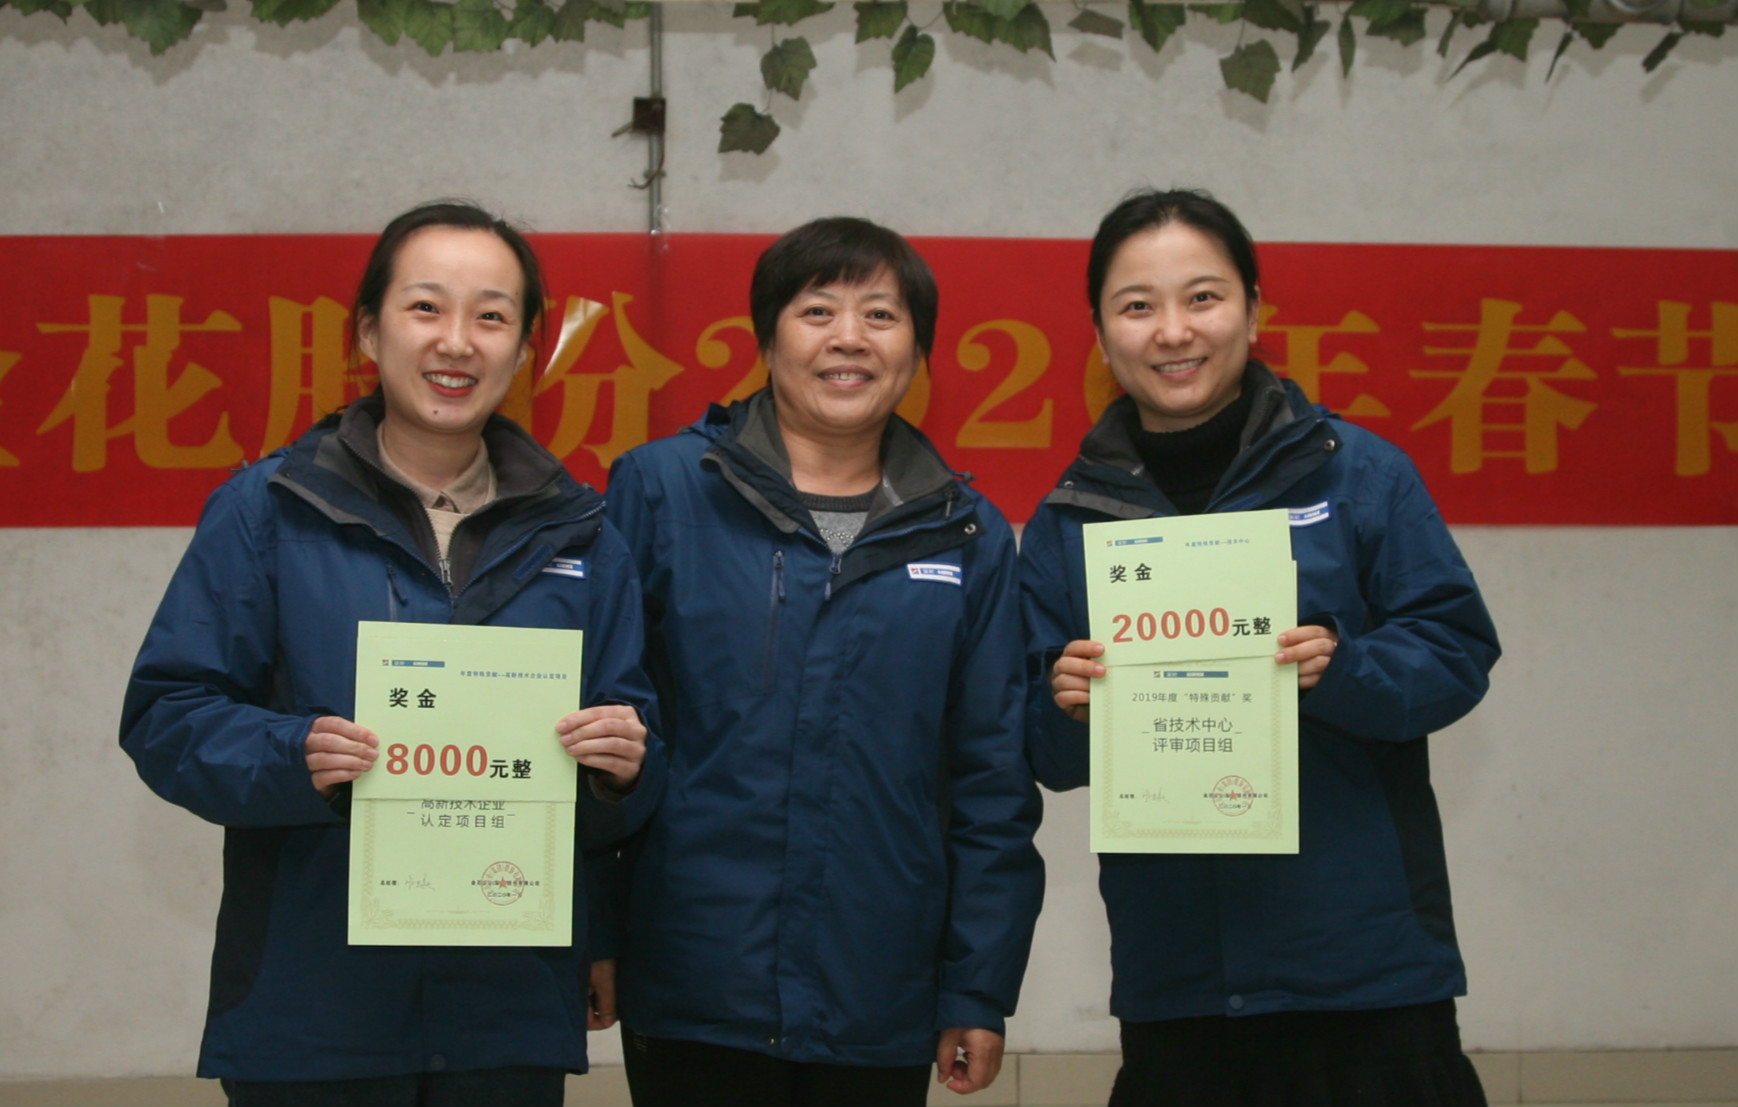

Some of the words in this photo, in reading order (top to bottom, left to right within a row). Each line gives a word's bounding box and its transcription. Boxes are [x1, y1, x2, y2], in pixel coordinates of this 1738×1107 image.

[1109, 563, 1152, 583] 奖金
[1112, 607, 1272, 643] 20000元整
[389, 687, 437, 709] 奖金
[1153, 717, 1233, 733] 省技术中心
[1153, 737, 1233, 753] 评审项目组
[386, 743, 532, 779] 8000元整
[421, 814, 505, 828] 认定项目组
